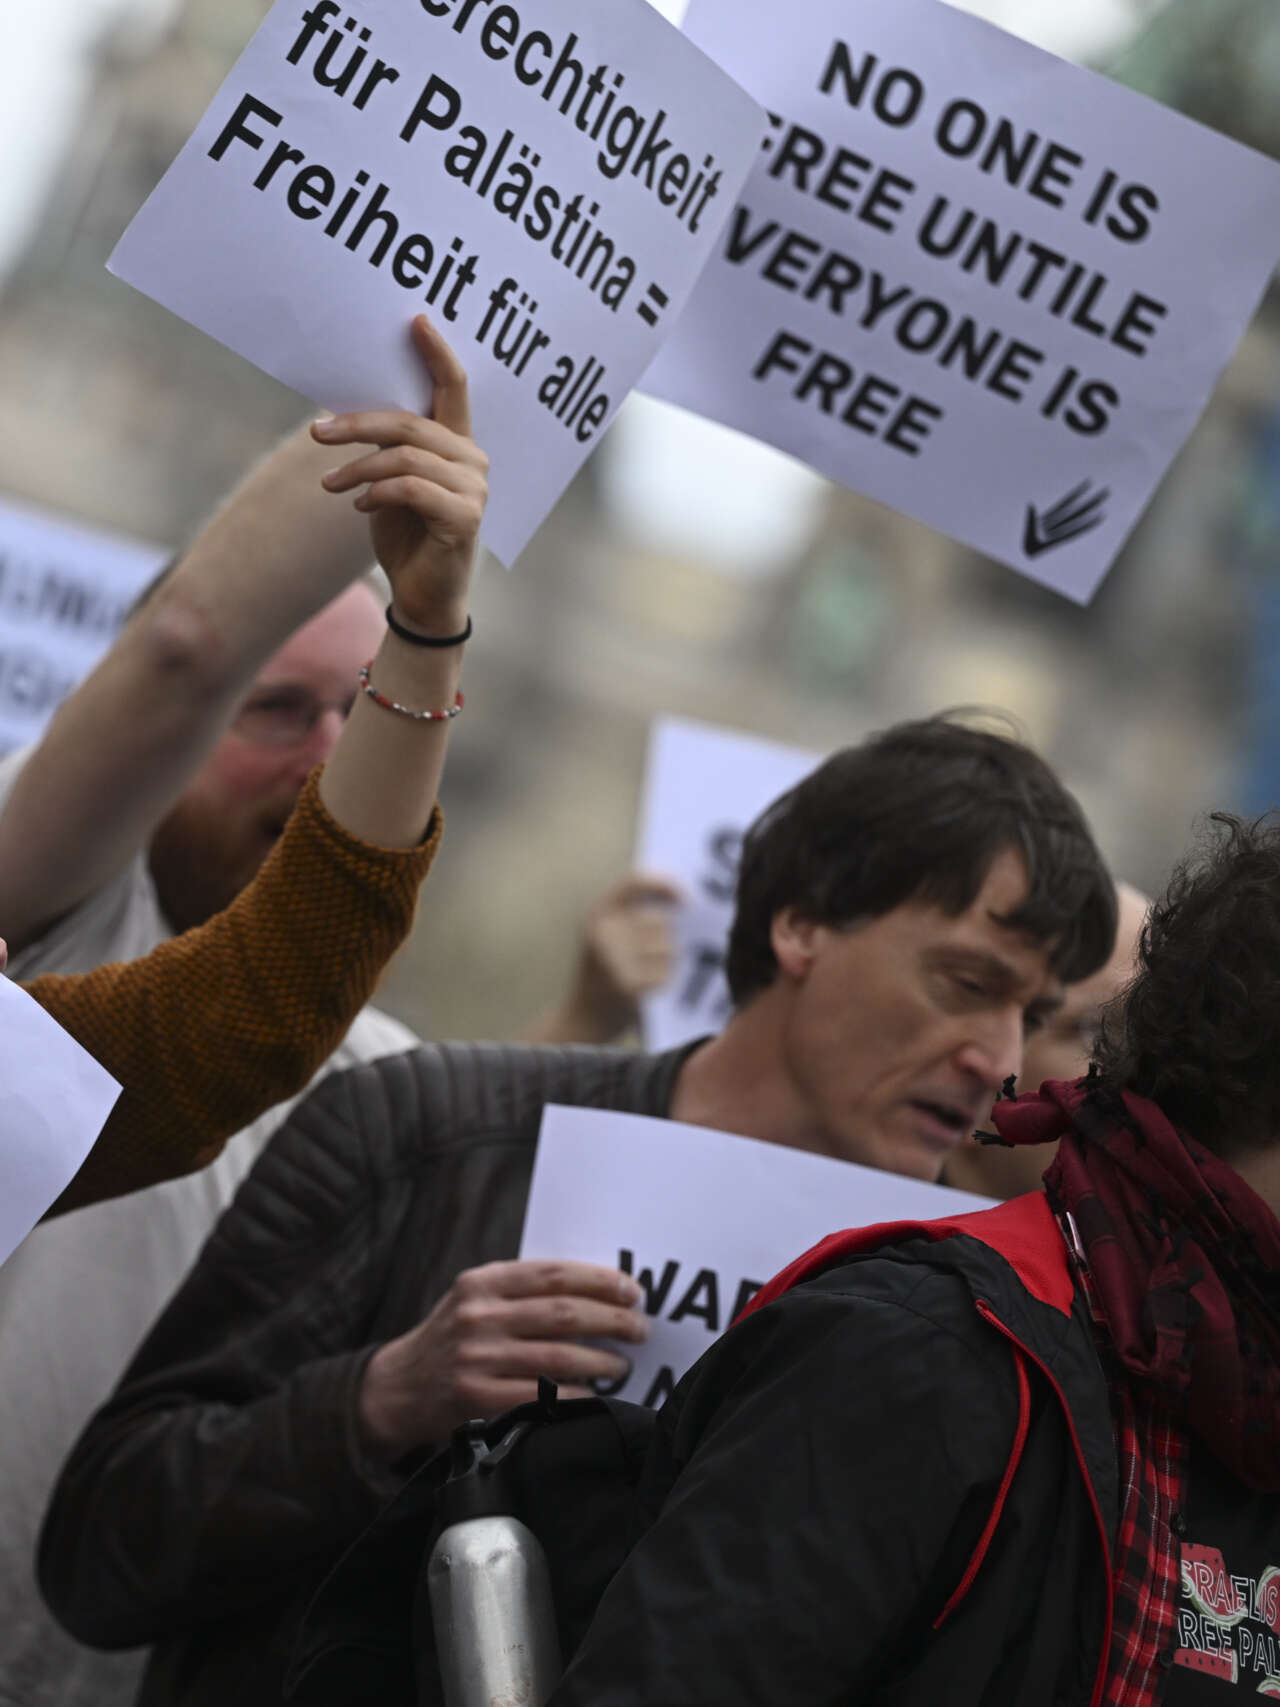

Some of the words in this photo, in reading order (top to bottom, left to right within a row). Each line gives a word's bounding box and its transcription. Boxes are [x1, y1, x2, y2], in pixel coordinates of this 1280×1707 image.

[285, 0, 400, 110] für
[400, 73, 637, 313] Palästina
[636, 282, 670, 327] =
[420, 0, 723, 235] rechtigkeit
[819, 38, 925, 128] NO
[934, 97, 1084, 209] ONE
[1083, 169, 1161, 244] IS
[207, 93, 480, 323] Freiheit
[474, 277, 551, 377] für
[537, 355, 611, 443] alle
[724, 204, 1045, 403] VERYONE
[1041, 366, 1120, 437] IS
[918, 196, 1167, 357] UNTILE
[752, 329, 944, 457] FREE
[1178, 1607, 1233, 1662] REE
[1238, 1626, 1280, 1679] PAL
